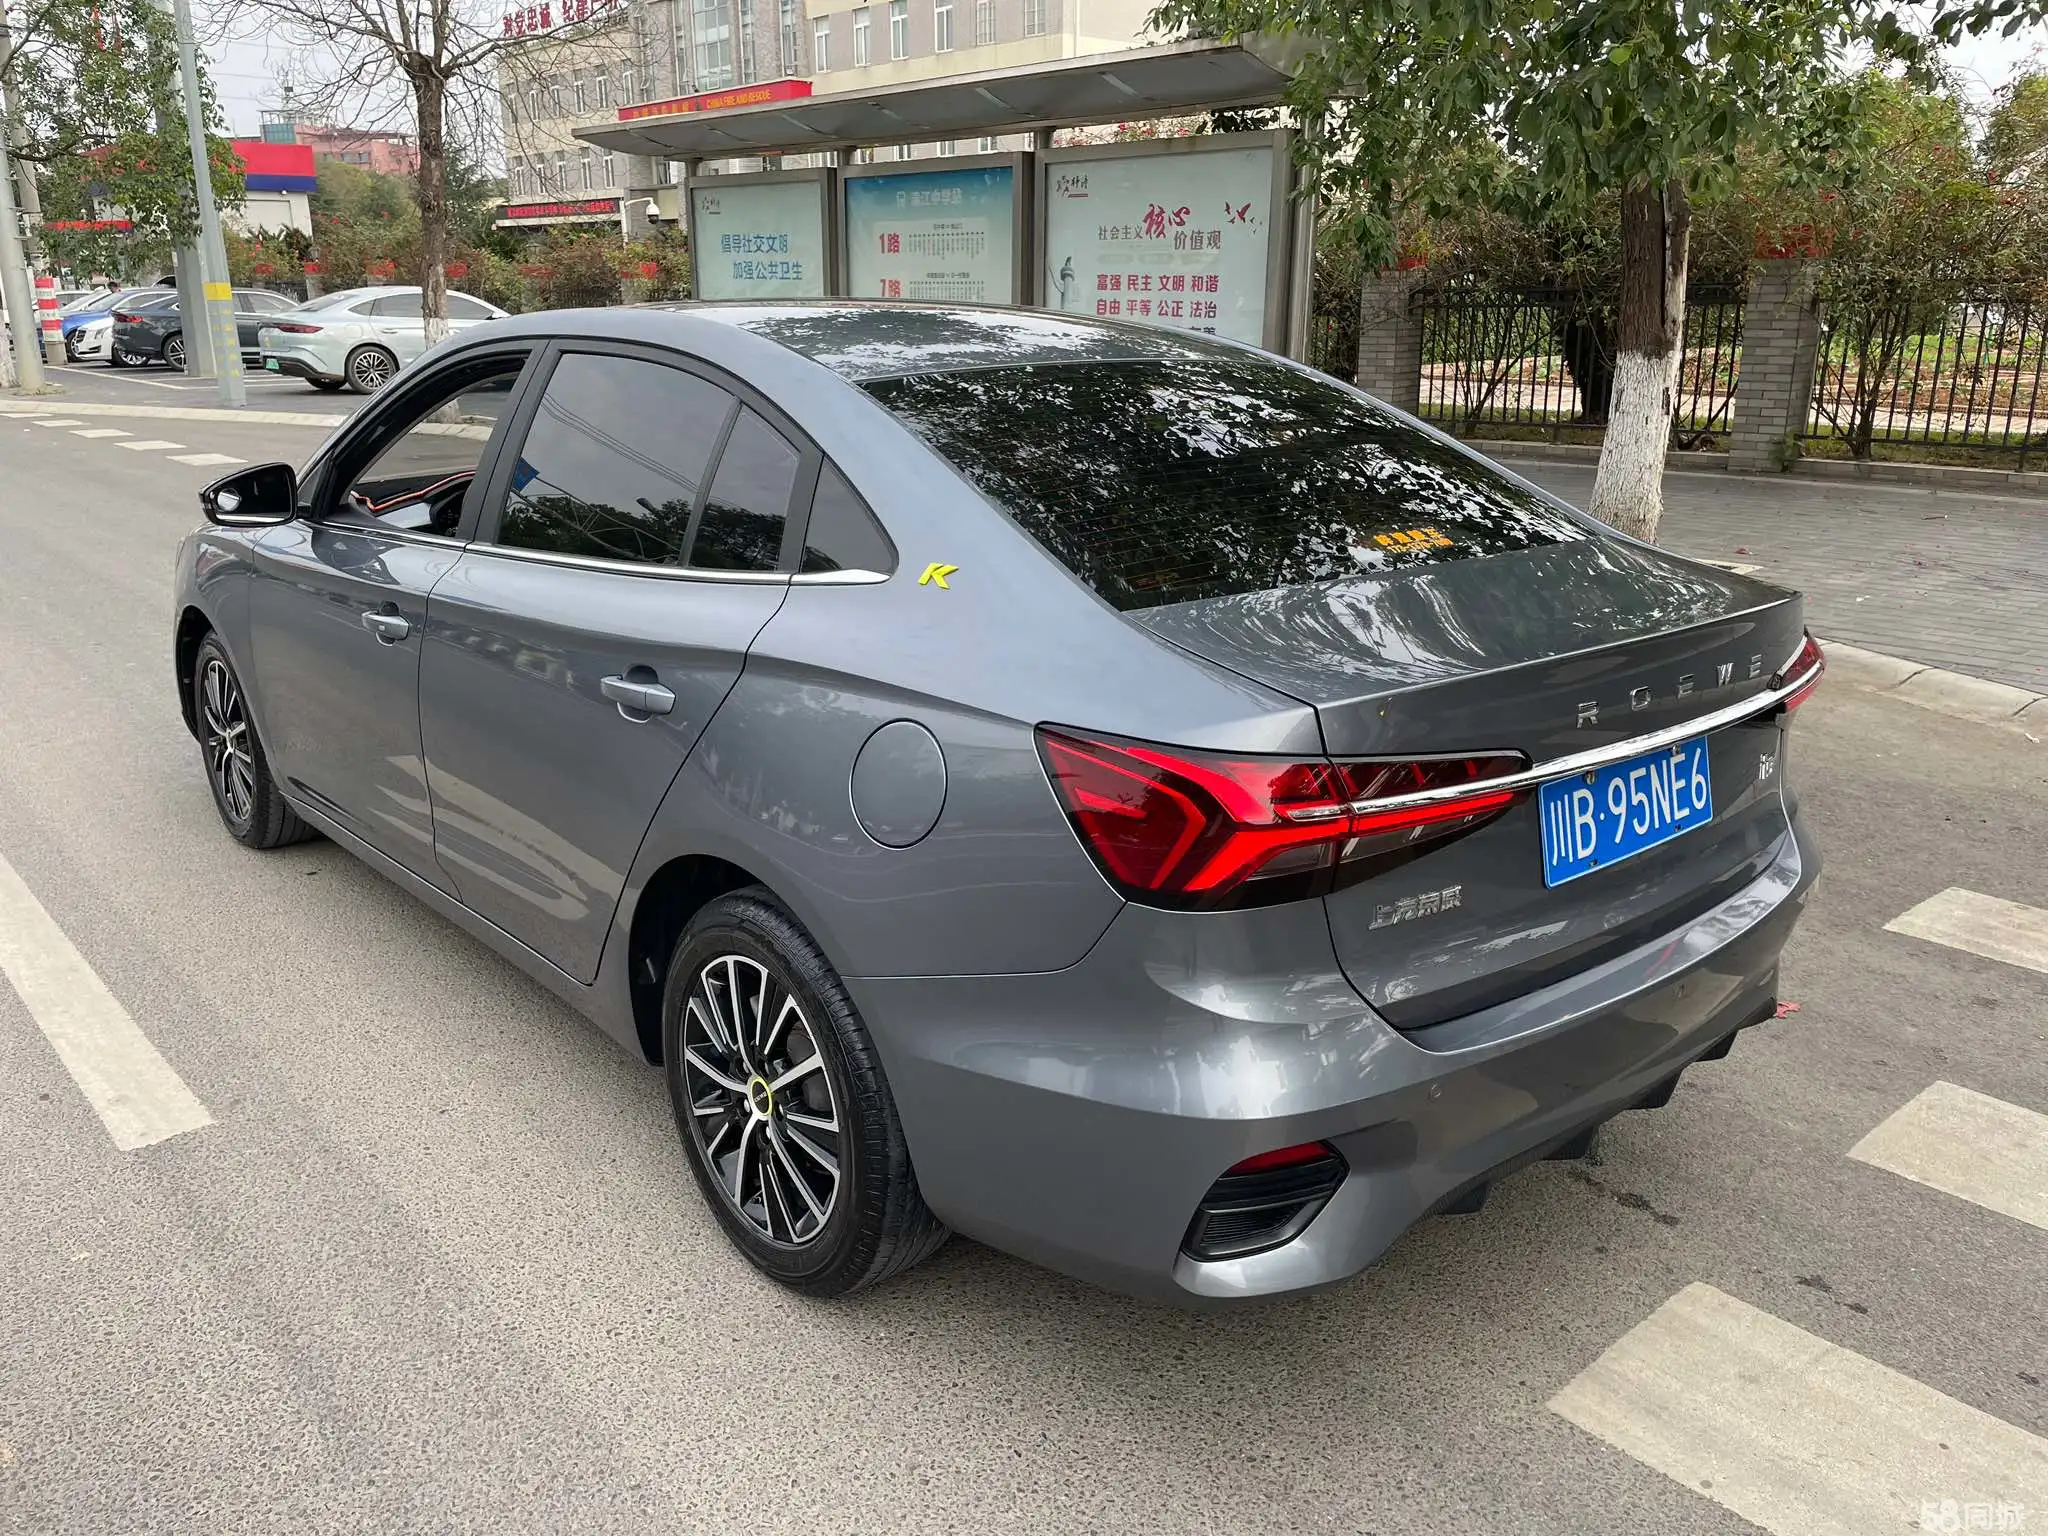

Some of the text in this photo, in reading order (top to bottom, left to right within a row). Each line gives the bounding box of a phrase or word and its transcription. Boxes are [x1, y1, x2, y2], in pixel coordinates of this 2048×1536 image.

[1098, 203, 1221, 250] 社会主义 核心 价值观
[721, 233, 788, 254] 倡导社交文明
[879, 233, 900, 254] 1路
[732, 260, 803, 280] 加强公共卫生
[1096, 272, 1219, 293] 富强 民主 文明 和谐
[1096, 299, 1217, 319] 自由 平等 公正 法治
[1577, 654, 1762, 729] ROEWE
